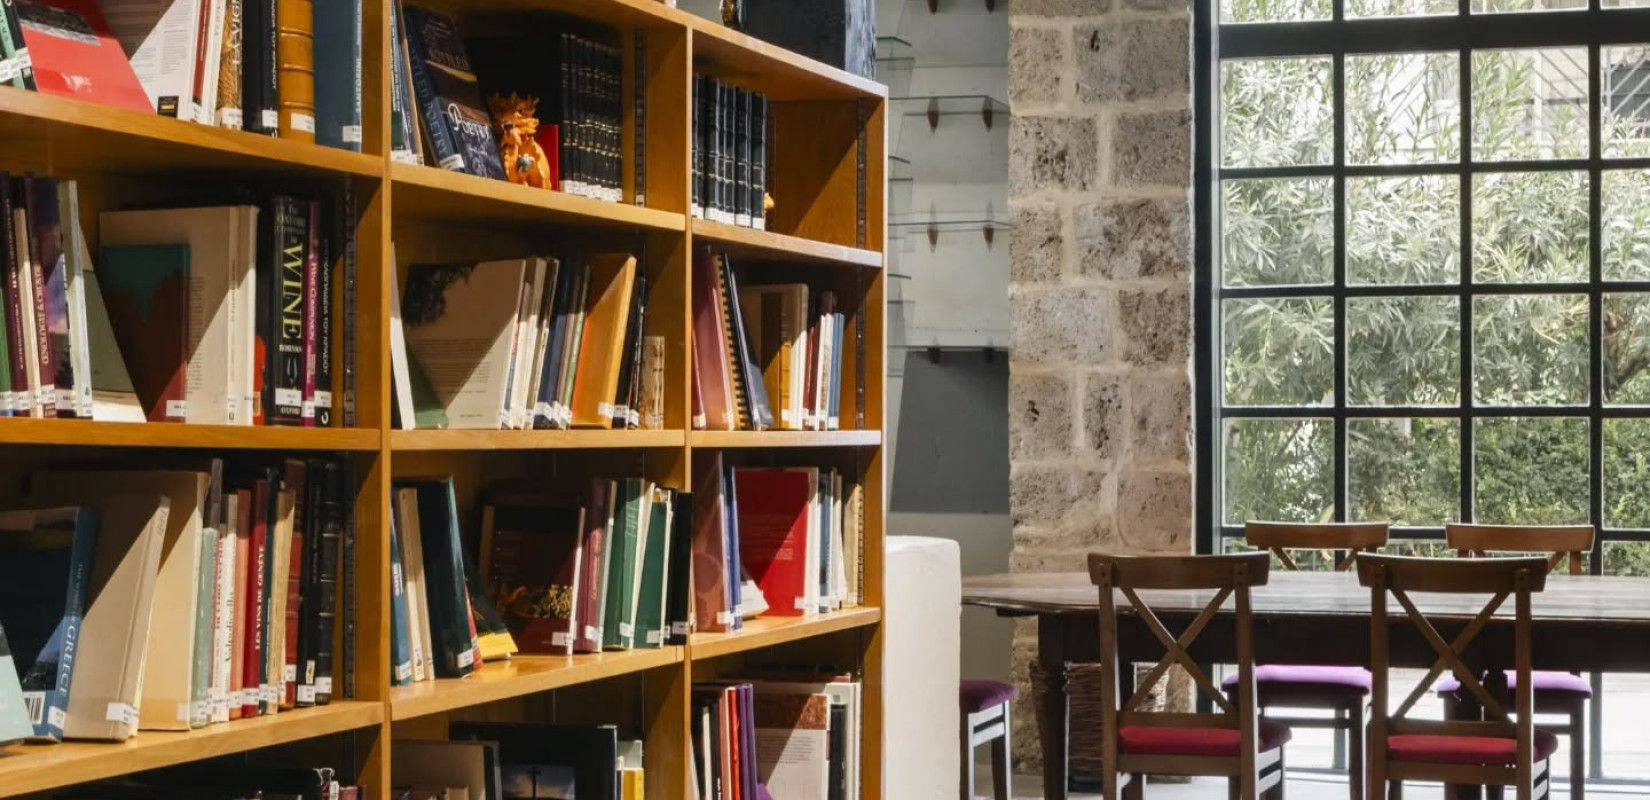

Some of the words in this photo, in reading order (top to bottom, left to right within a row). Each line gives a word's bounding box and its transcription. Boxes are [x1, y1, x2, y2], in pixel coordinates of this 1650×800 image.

[425, 102, 450, 158] POETRY
[282, 243, 303, 339] WINE
[257, 589, 263, 603] DE
[59, 625, 76, 697] GREECE
